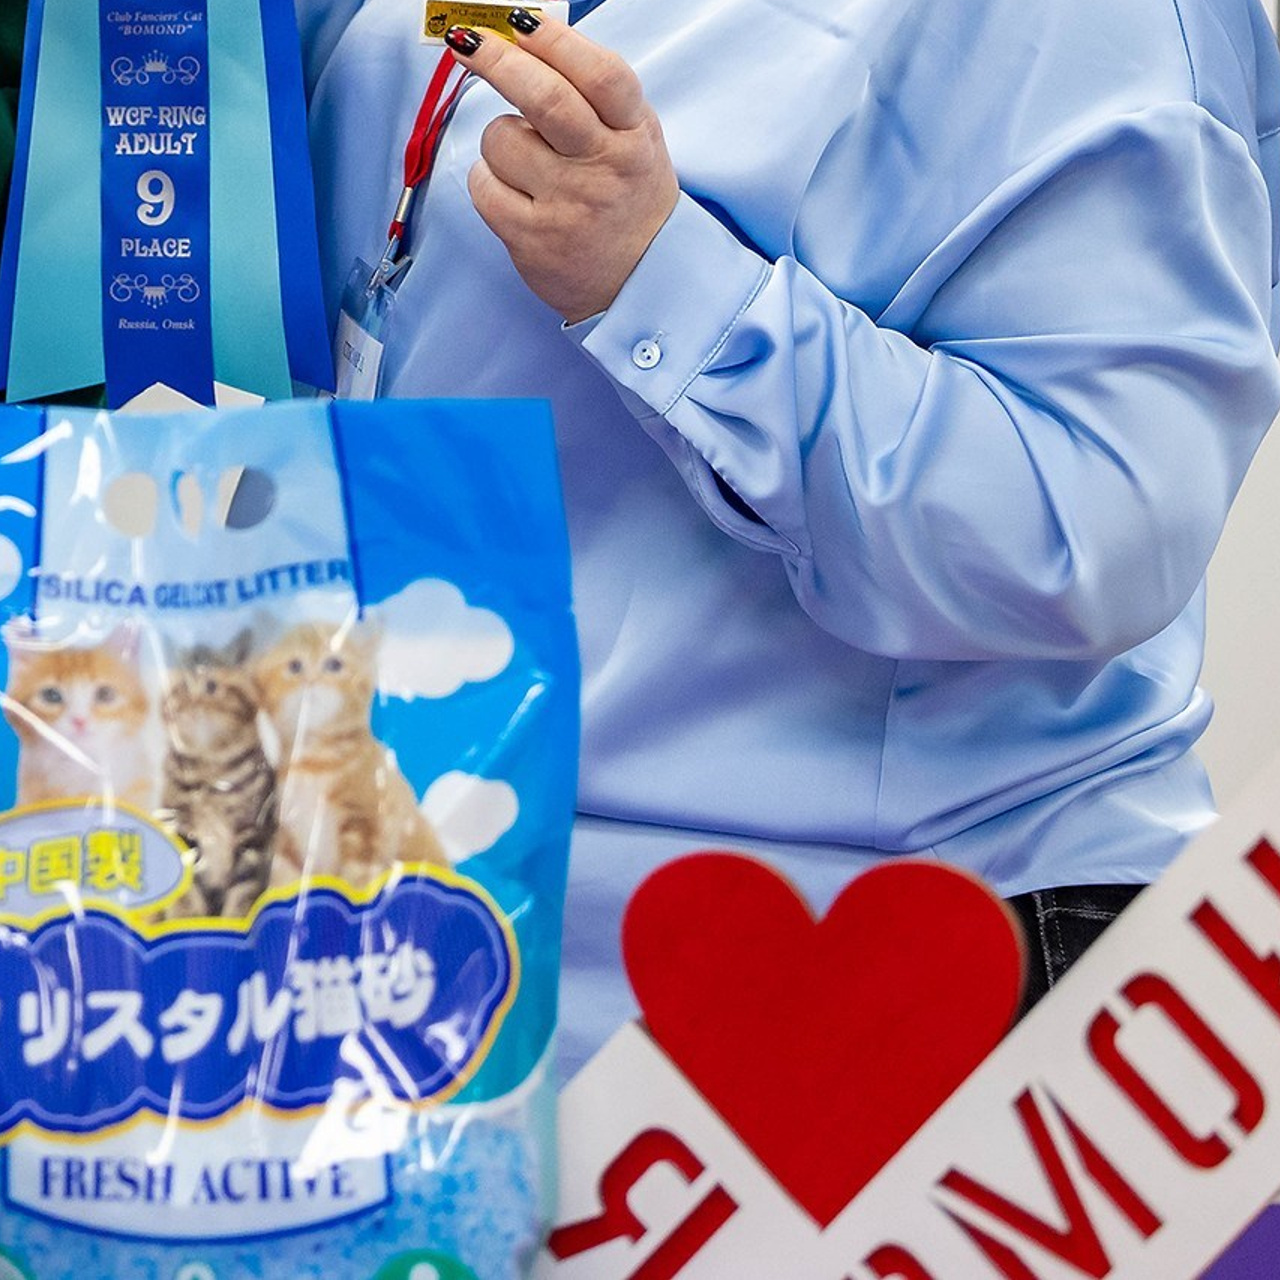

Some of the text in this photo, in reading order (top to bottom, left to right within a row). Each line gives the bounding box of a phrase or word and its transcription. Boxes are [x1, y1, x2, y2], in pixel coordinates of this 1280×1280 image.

[107, 11, 132, 22] Club
[184, 11, 203, 22] Cat
[106, 105, 207, 128] WCF-RING
[115, 132, 197, 155] ADULT
[136, 169, 176, 226] 9
[120, 238, 192, 258] PLACE
[118, 317, 196, 331] Russia, Omsk
[41, 573, 147, 608] SILICA
[236, 557, 350, 603] LITTER
[40, 1157, 174, 1203] FRESH
